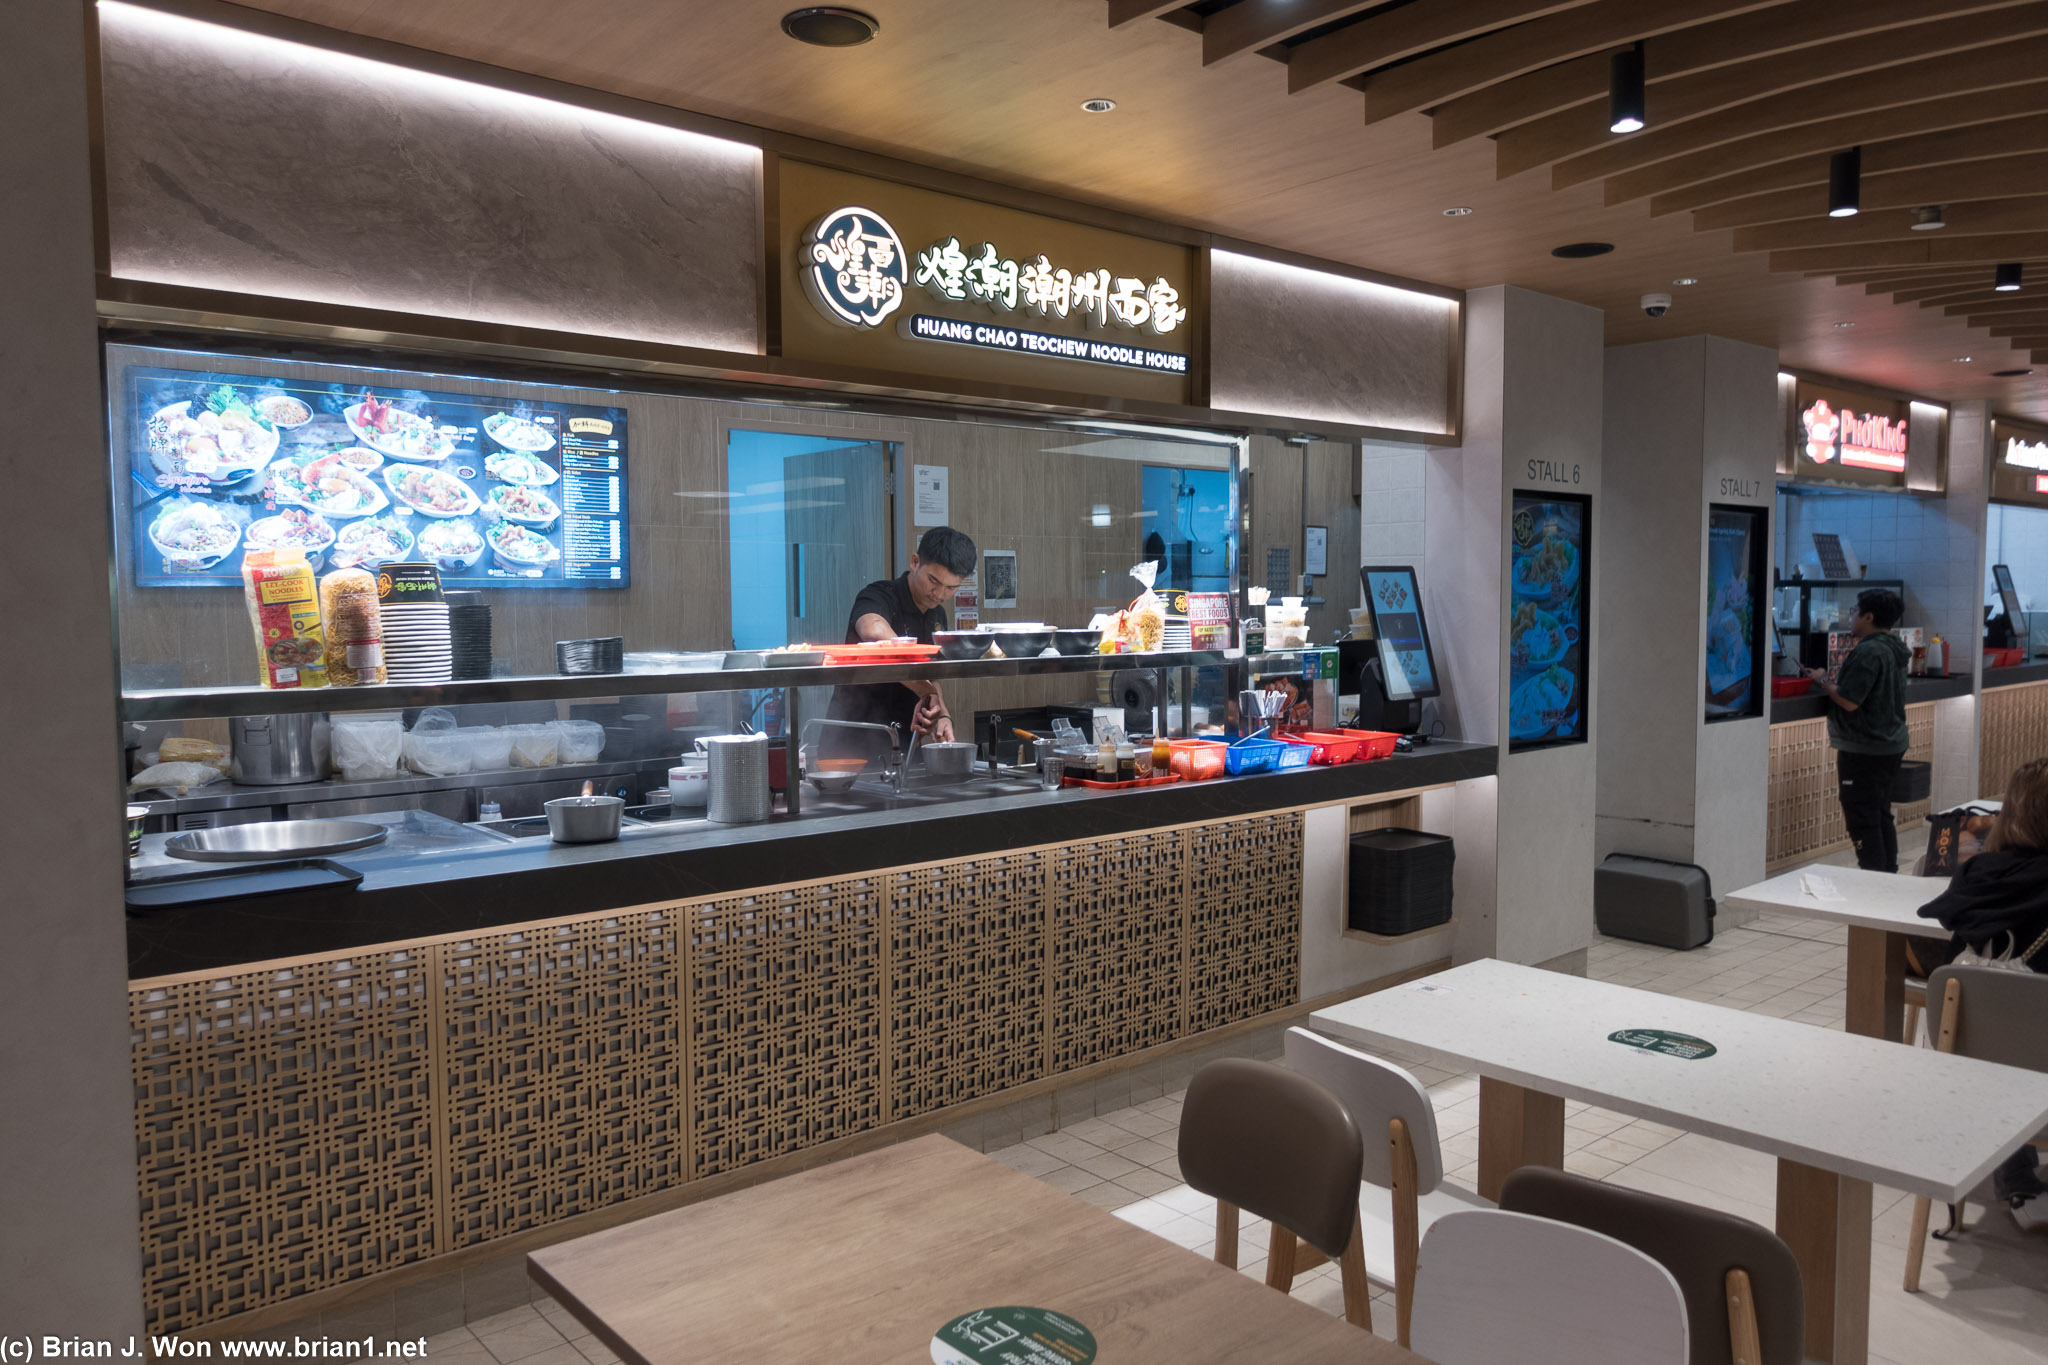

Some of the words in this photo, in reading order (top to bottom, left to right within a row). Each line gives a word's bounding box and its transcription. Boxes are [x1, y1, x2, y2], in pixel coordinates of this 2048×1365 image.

[917, 317, 973, 340] HUANG
[975, 326, 1018, 347] CHAO
[1020, 333, 1089, 357] TEOCHEW
[1091, 343, 1144, 365] NOODLE
[1146, 351, 1186, 371] HOUSE
[1527, 459, 1569, 483] STALL
[1573, 464, 1580, 484] 6
[1720, 478, 1751, 497] STALL
[1754, 481, 1760, 497] 7
[265, 579, 304, 588] EZY-COOK
[268, 586, 304, 595] NOODLES
[1189, 597, 1228, 608] SINGAPORE
[1191, 609, 1207, 619] BEST
[1208, 608, 1228, 618] FOODS
